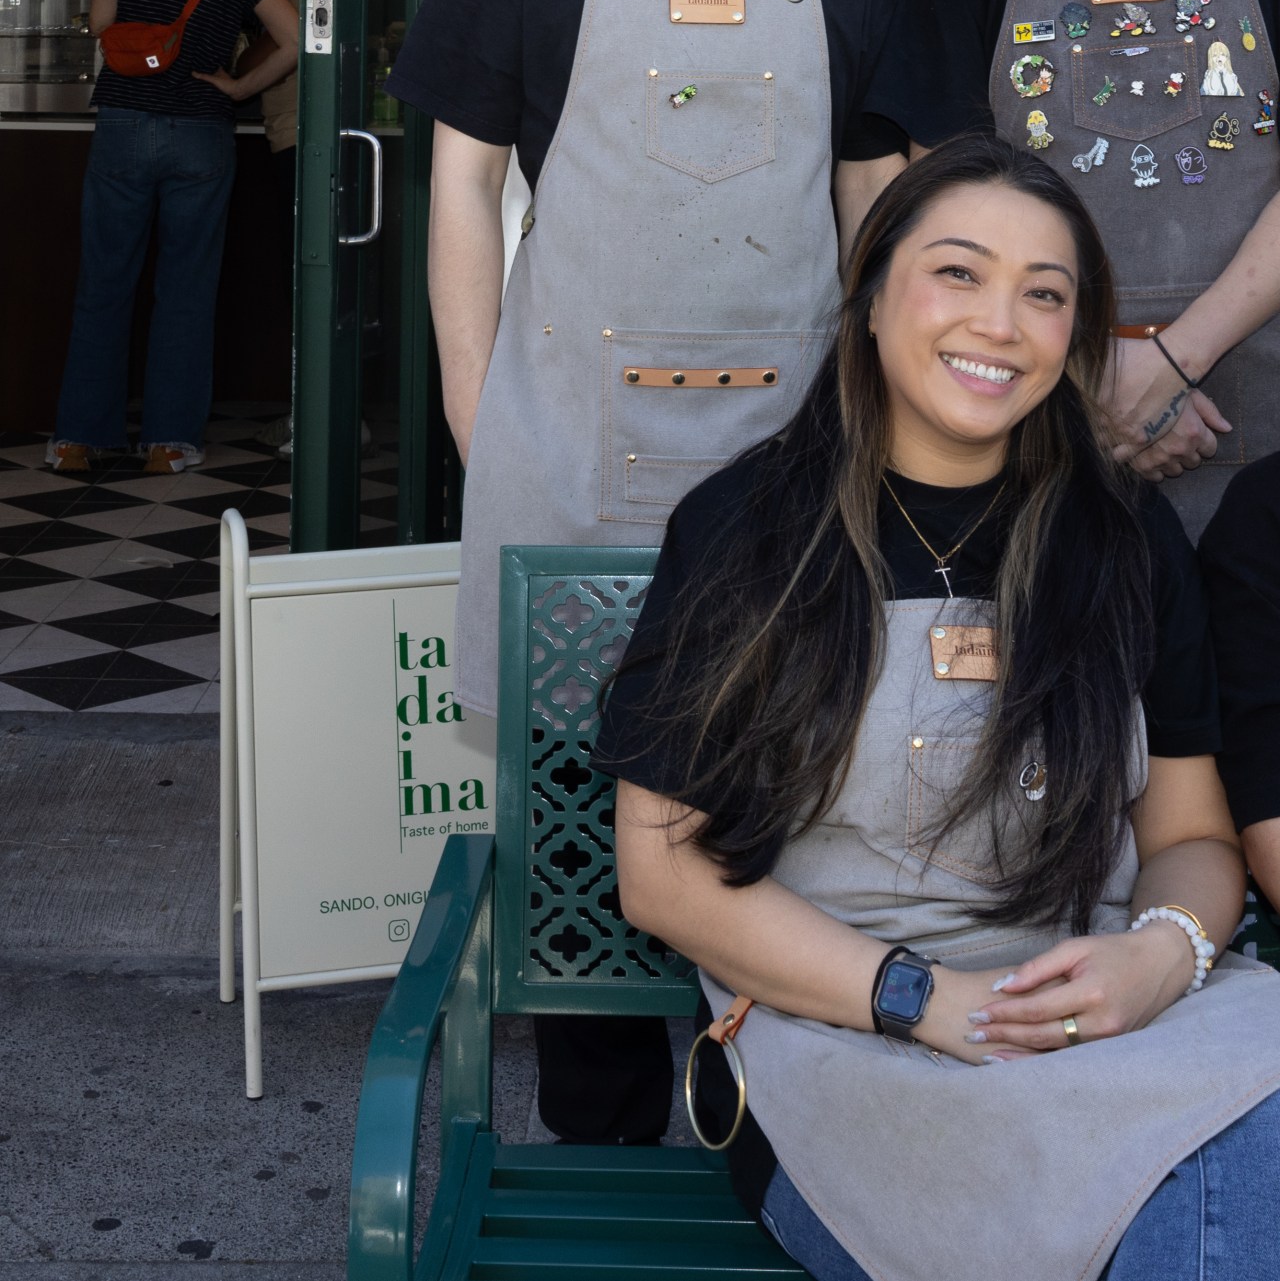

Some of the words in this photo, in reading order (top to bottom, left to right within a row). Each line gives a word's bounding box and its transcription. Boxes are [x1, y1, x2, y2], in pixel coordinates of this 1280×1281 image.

[395, 631, 451, 671] ta
[399, 777, 489, 817] ma
[401, 825, 435, 838] Taste
[439, 821, 452, 835] of
[456, 820, 489, 833] home
[319, 895, 380, 914] SANDO,
[383, 890, 431, 908] ONIGI
